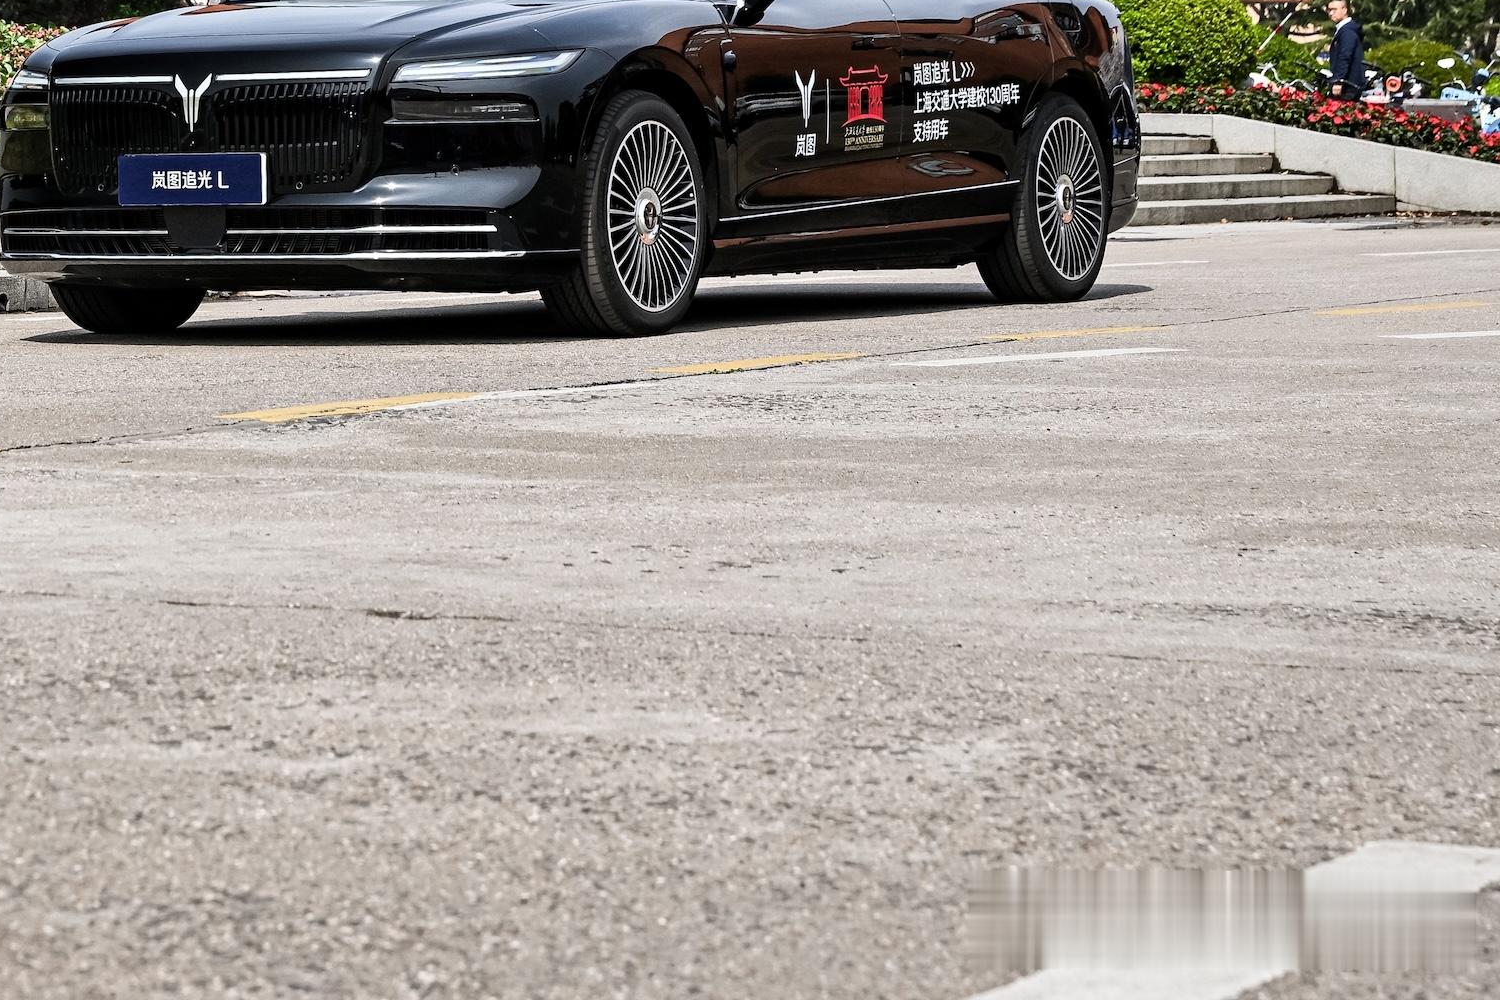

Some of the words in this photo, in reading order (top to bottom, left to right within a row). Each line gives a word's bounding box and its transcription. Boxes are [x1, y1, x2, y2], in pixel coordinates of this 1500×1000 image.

[913, 60, 950, 86] 岚图追光
[913, 83, 1020, 114] 上海交通大学建校130周年
[912, 118, 949, 143] 支持用车
[795, 133, 816, 157] 岚图
[151, 170, 213, 190] 岚图追光
[217, 170, 229, 189] L
